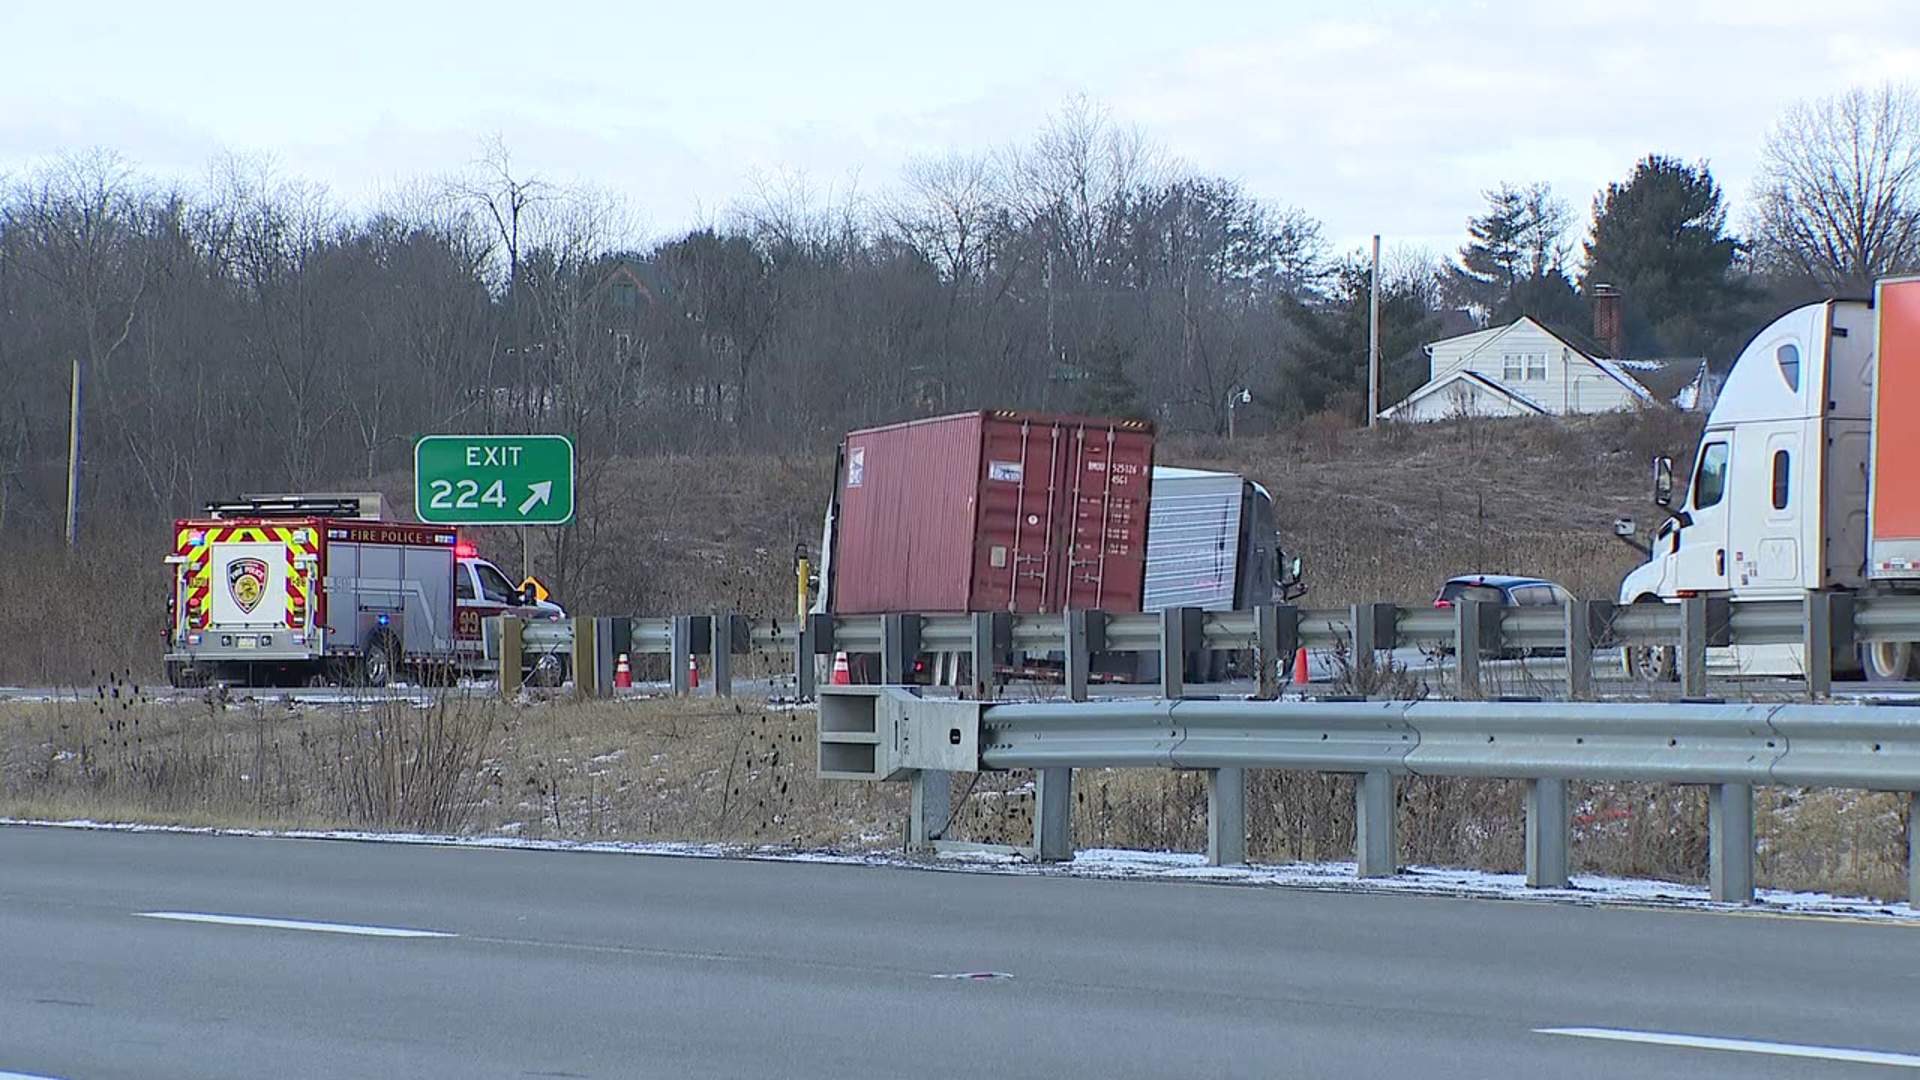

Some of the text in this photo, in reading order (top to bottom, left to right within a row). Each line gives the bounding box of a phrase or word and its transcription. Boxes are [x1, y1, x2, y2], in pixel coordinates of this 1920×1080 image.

[466, 446, 523, 466] EXIT
[1112, 463, 1137, 475] 525126
[430, 479, 507, 508] 224
[351, 530, 376, 541] FIRE
[381, 531, 423, 543] POLICE
[459, 611, 480, 634] 99
